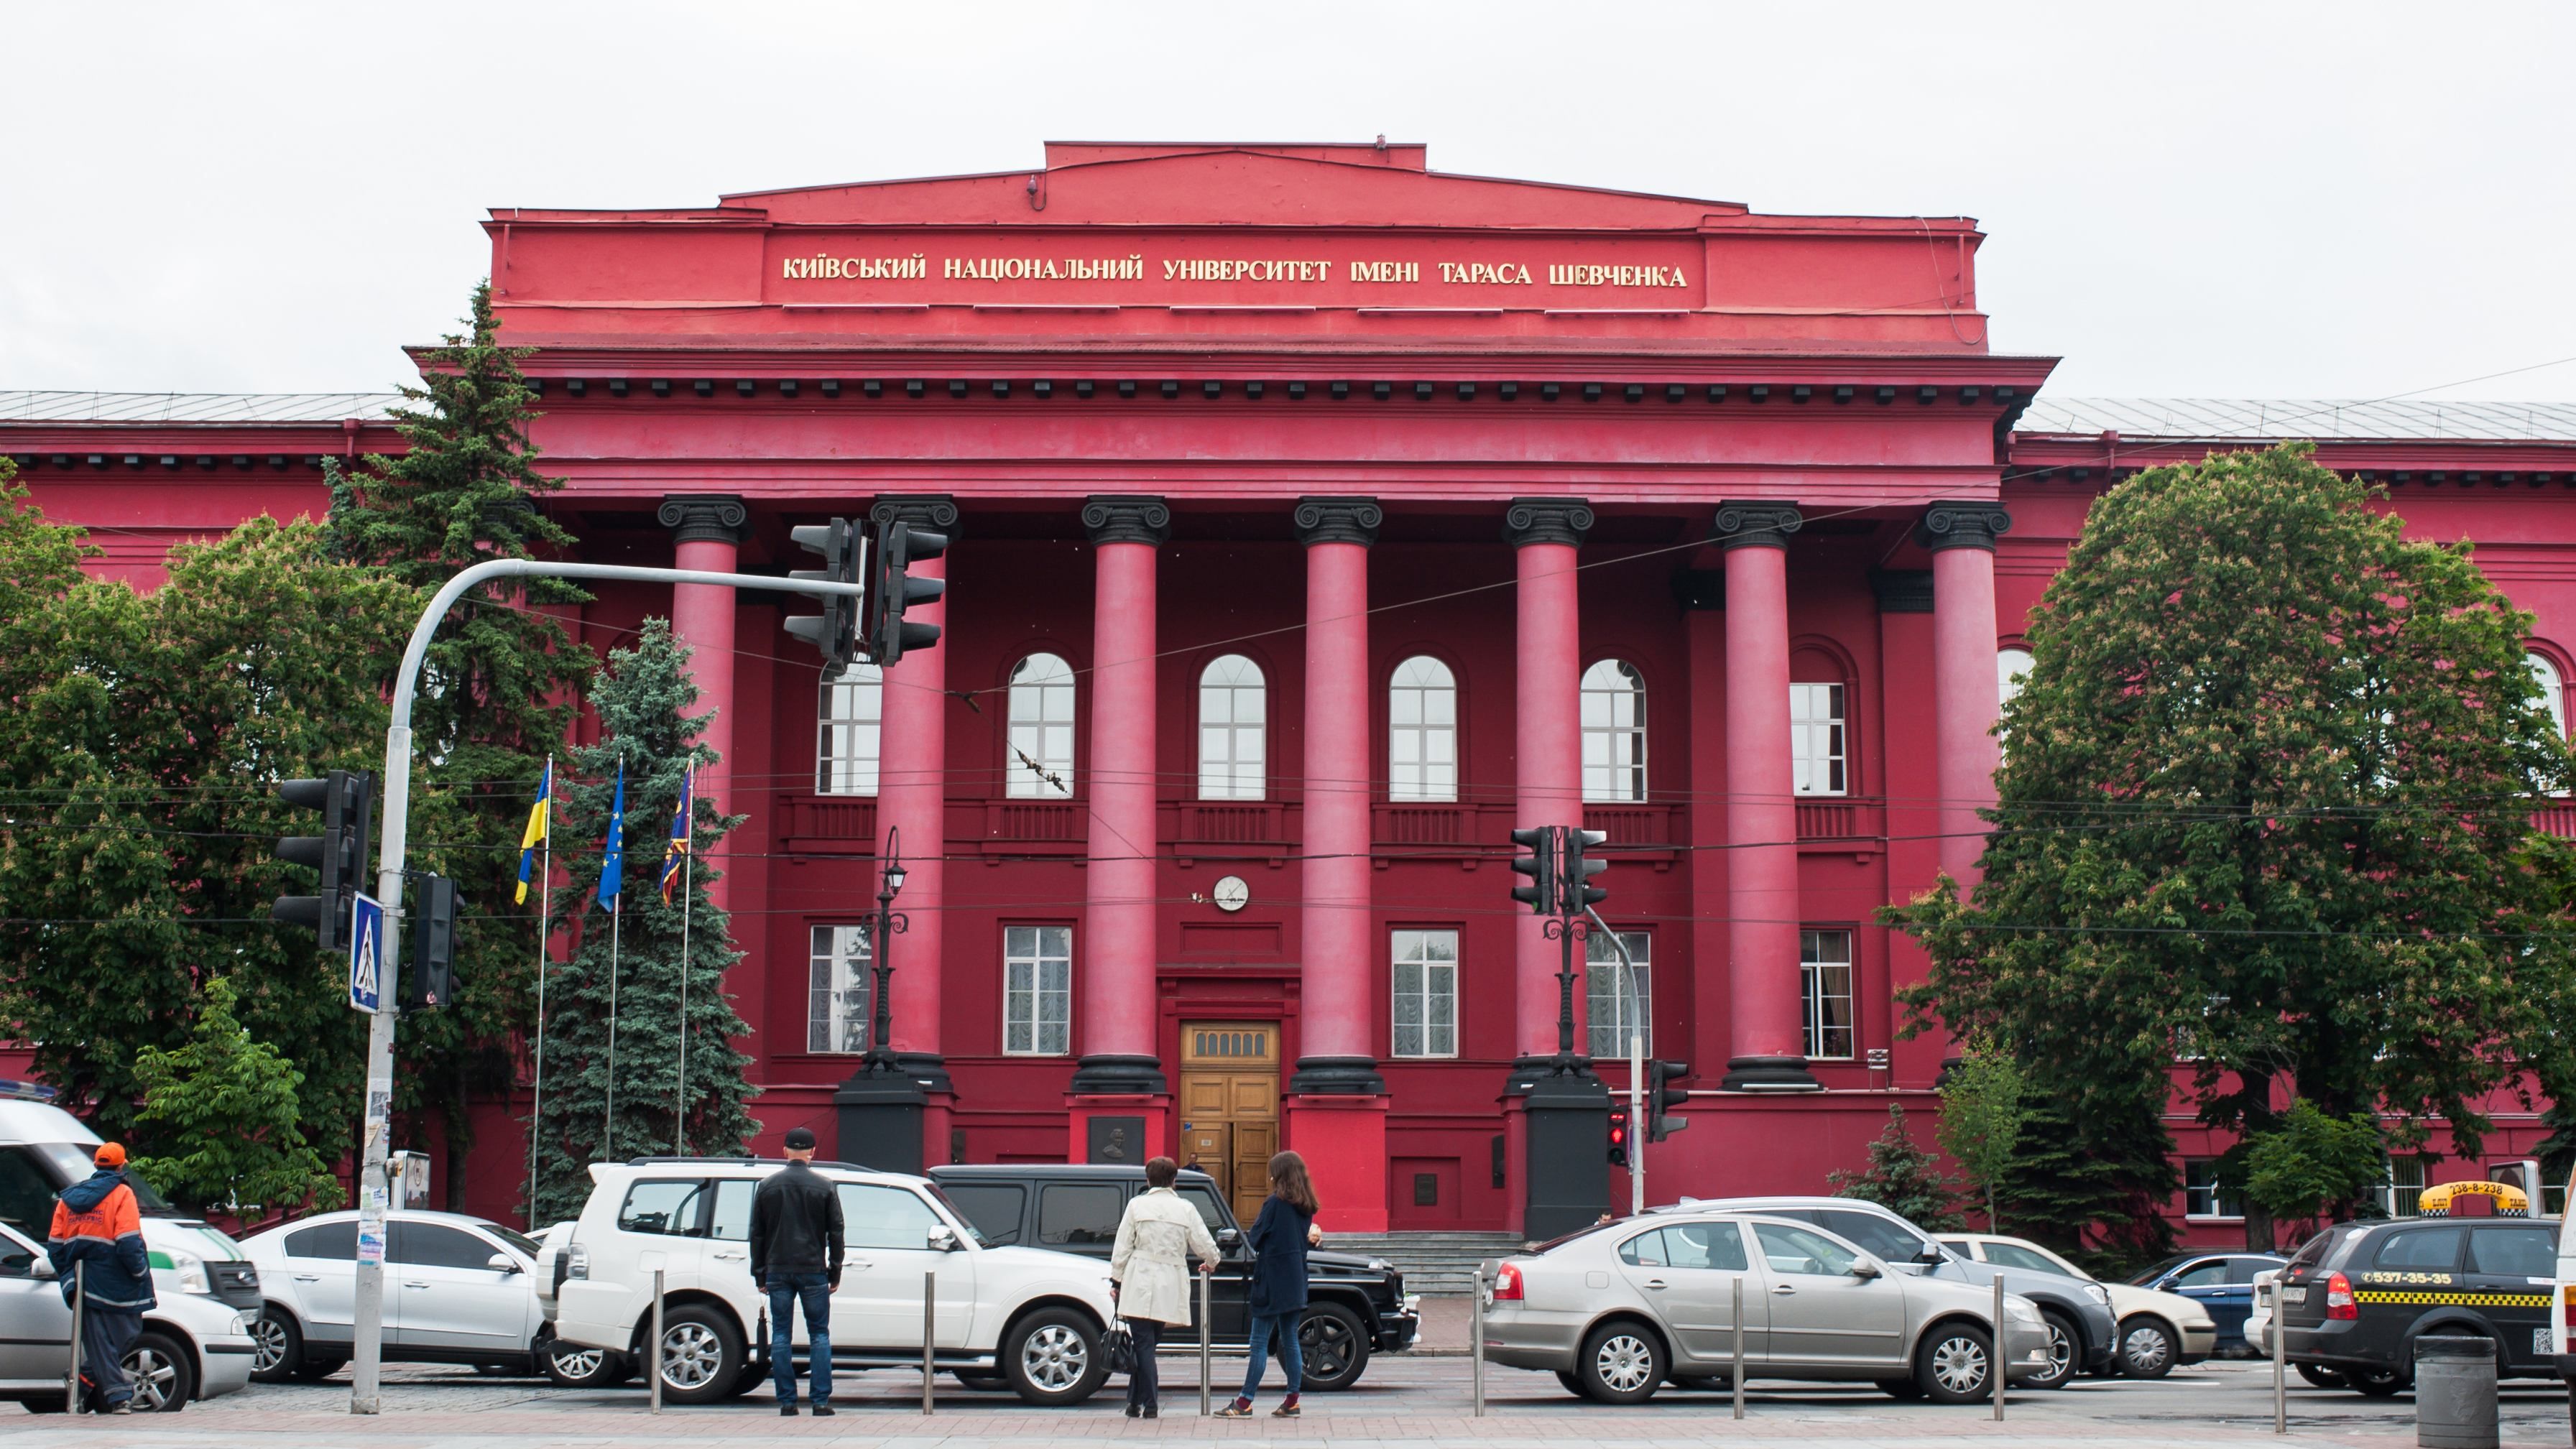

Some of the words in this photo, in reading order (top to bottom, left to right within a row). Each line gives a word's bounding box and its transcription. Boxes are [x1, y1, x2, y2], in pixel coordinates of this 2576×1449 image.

[783, 252, 926, 279] КИЇВСЬКИЙ
[944, 254, 1143, 283] НАЦІОНАЛЬНИЙ
[1163, 259, 1331, 282] УНІВЕРСИТЕТ
[1350, 261, 1419, 283] ІМЕНІ
[1438, 262, 1533, 285] ТАРАСА
[1549, 264, 1688, 288] ШЕВЧЕНКА
[2449, 1182, 2503, 1195] 238-8-238
[2373, 1272, 2452, 1284] 537-35-35
